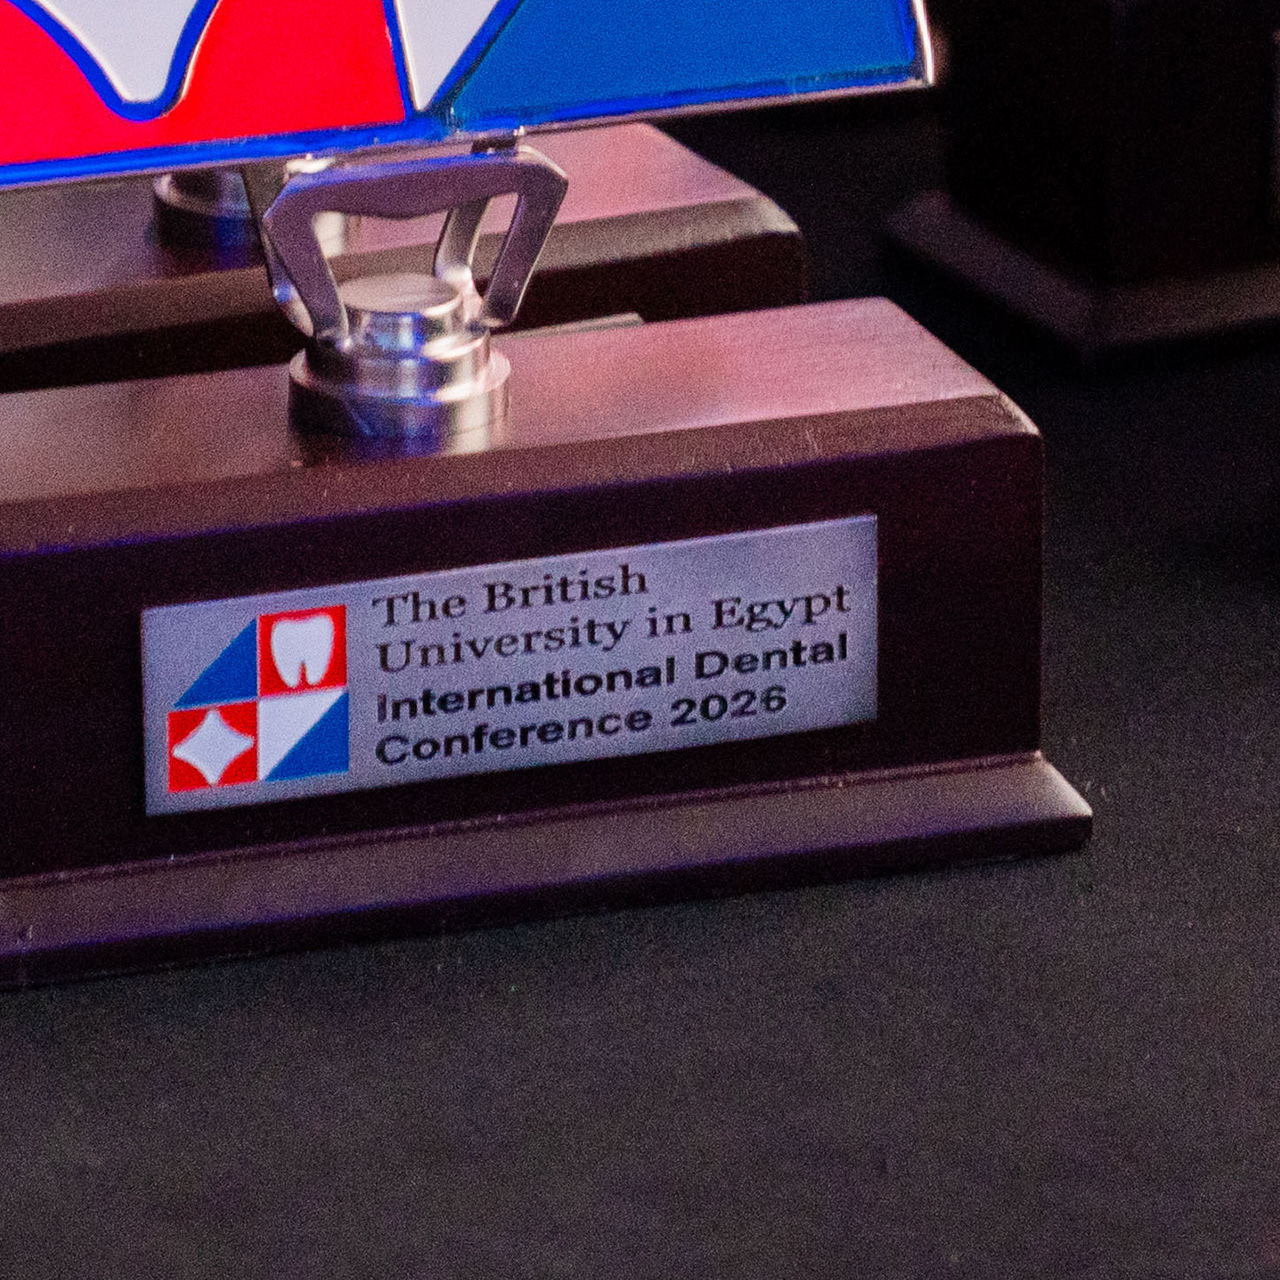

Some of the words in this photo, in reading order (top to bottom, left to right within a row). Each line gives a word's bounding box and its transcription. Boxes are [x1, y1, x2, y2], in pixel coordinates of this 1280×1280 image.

[371, 590, 468, 628] The
[483, 563, 649, 615] British
[375, 614, 632, 674] University
[645, 606, 693, 638] in
[710, 583, 851, 633] Egypt
[376, 654, 676, 723] International
[694, 630, 849, 681] Dental
[374, 707, 653, 767] Conference
[669, 683, 788, 728] 2026
